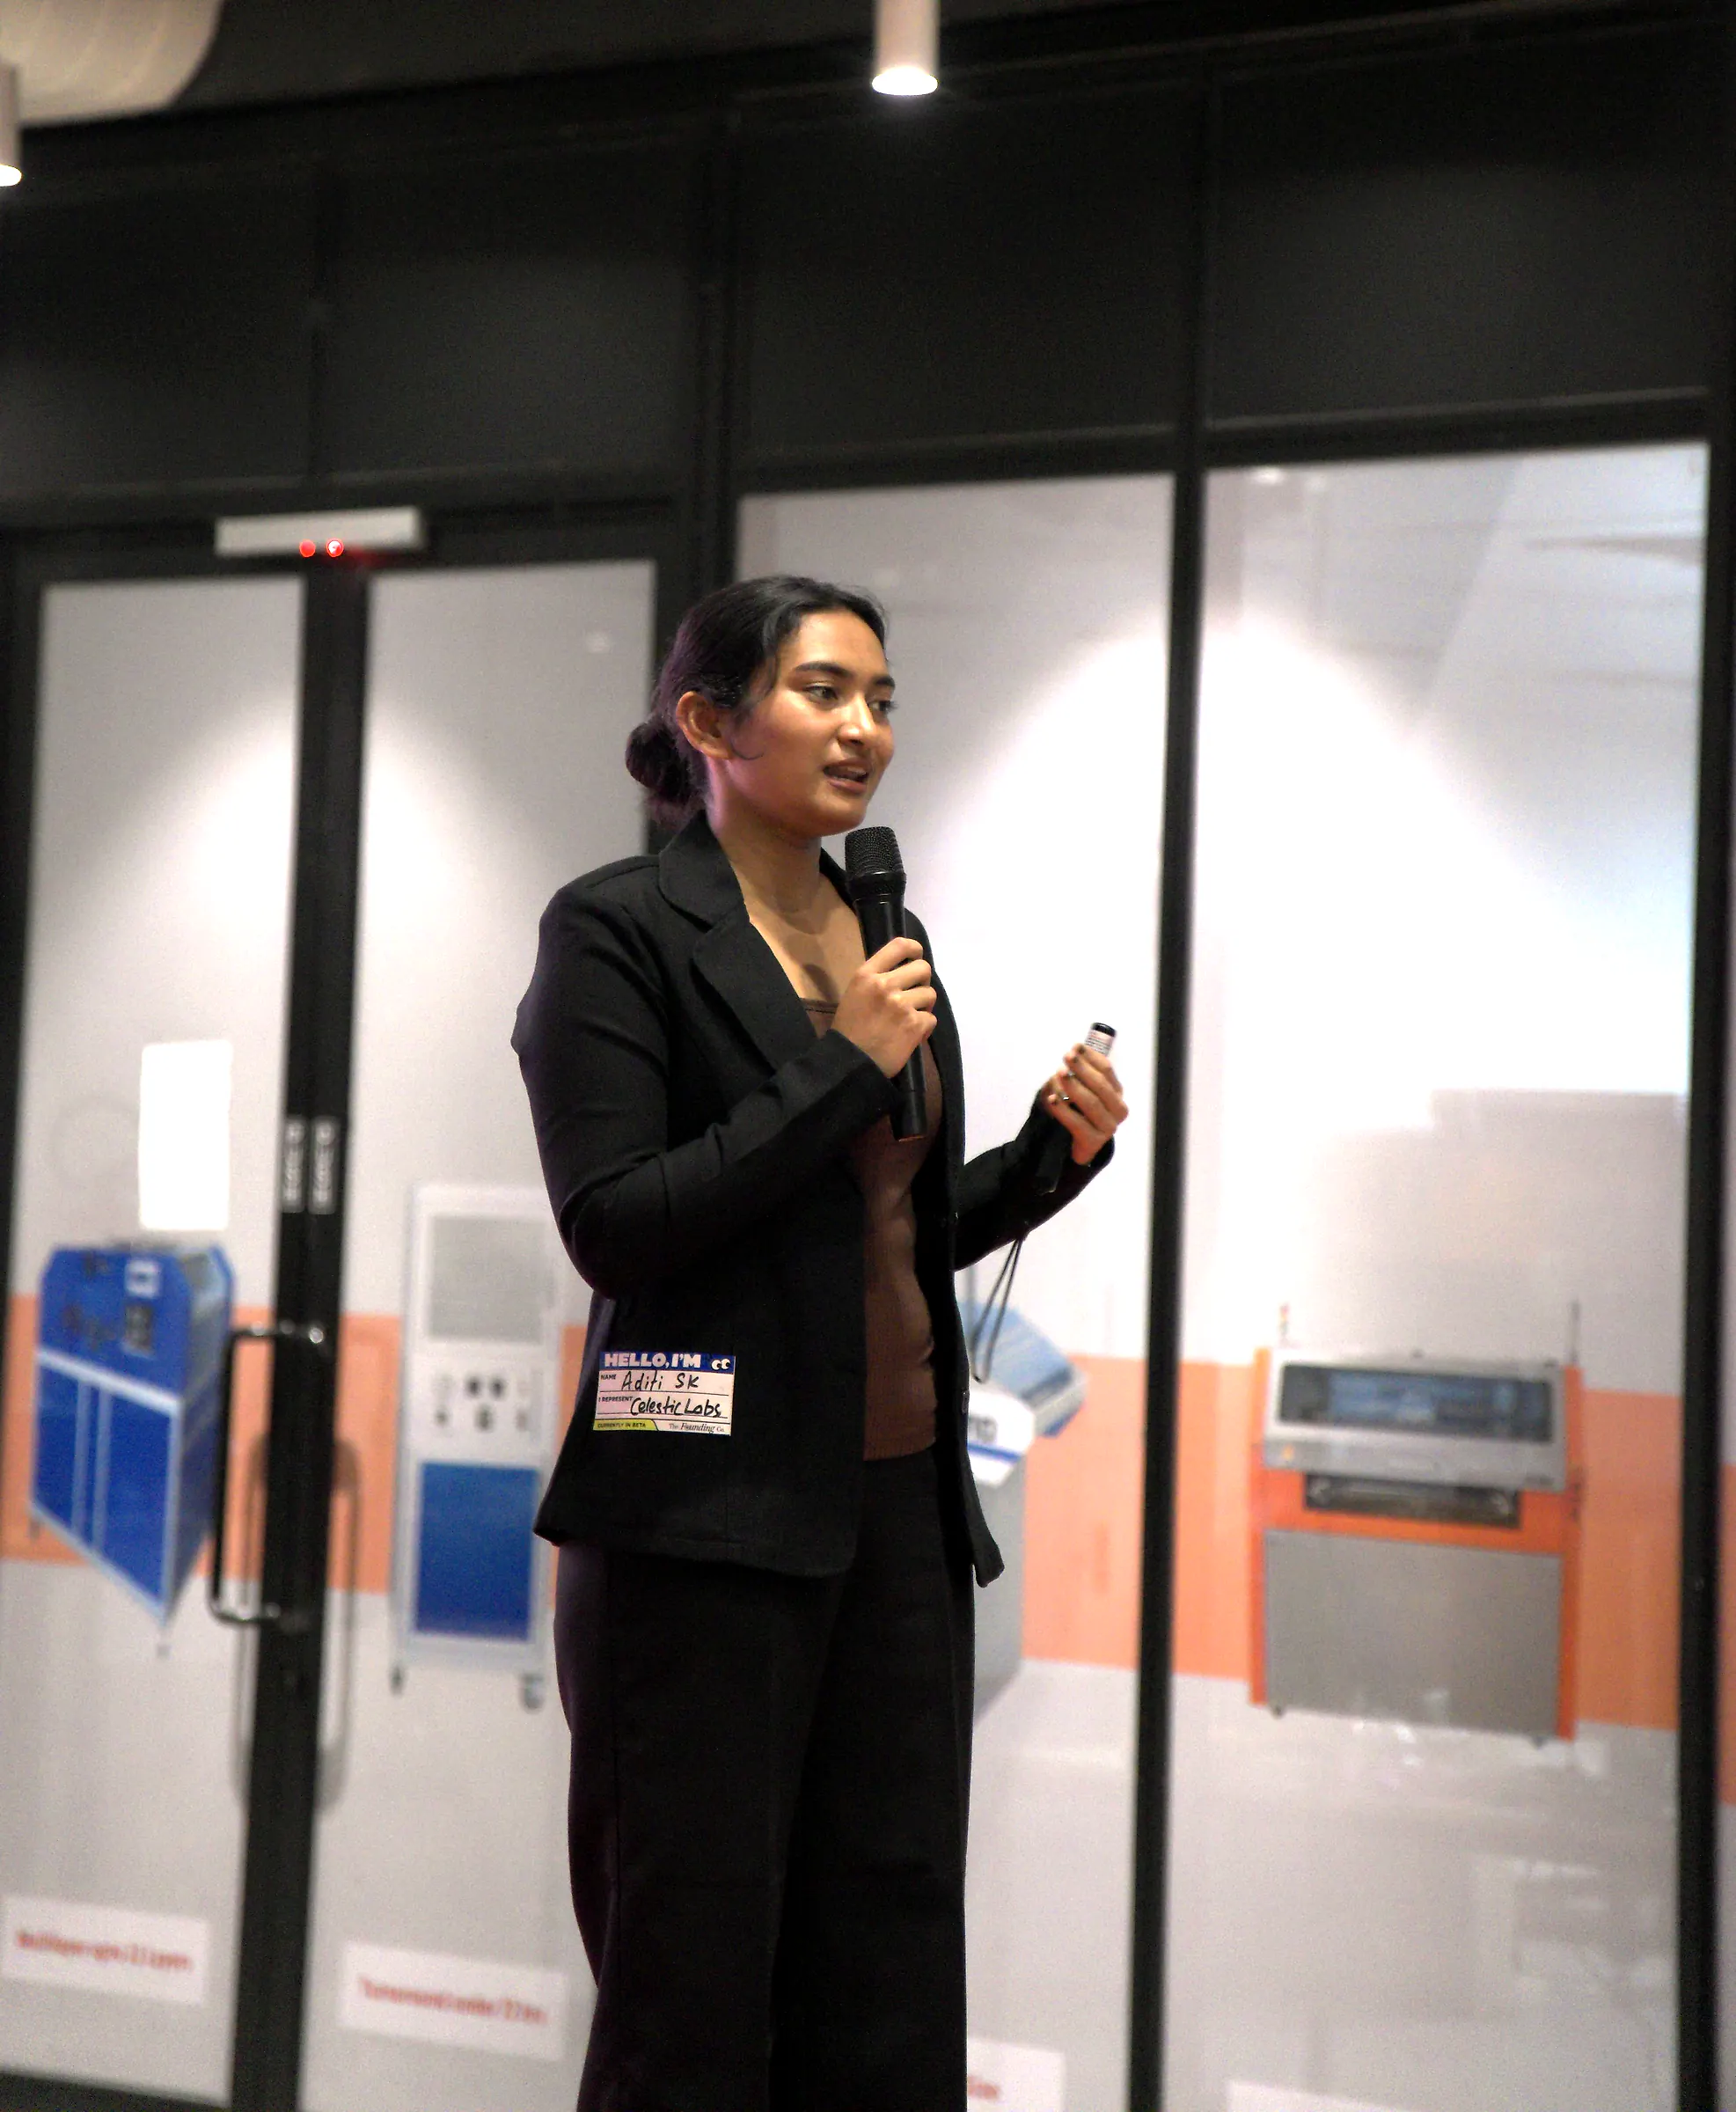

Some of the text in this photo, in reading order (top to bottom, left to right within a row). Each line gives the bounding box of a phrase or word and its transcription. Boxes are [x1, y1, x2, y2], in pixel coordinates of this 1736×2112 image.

[604, 1353, 700, 1368] HELLO, I'M
[621, 1370, 663, 1391] Aditi
[630, 1396, 721, 1418] Celestic Labs
[680, 1423, 716, 1434] Founding
